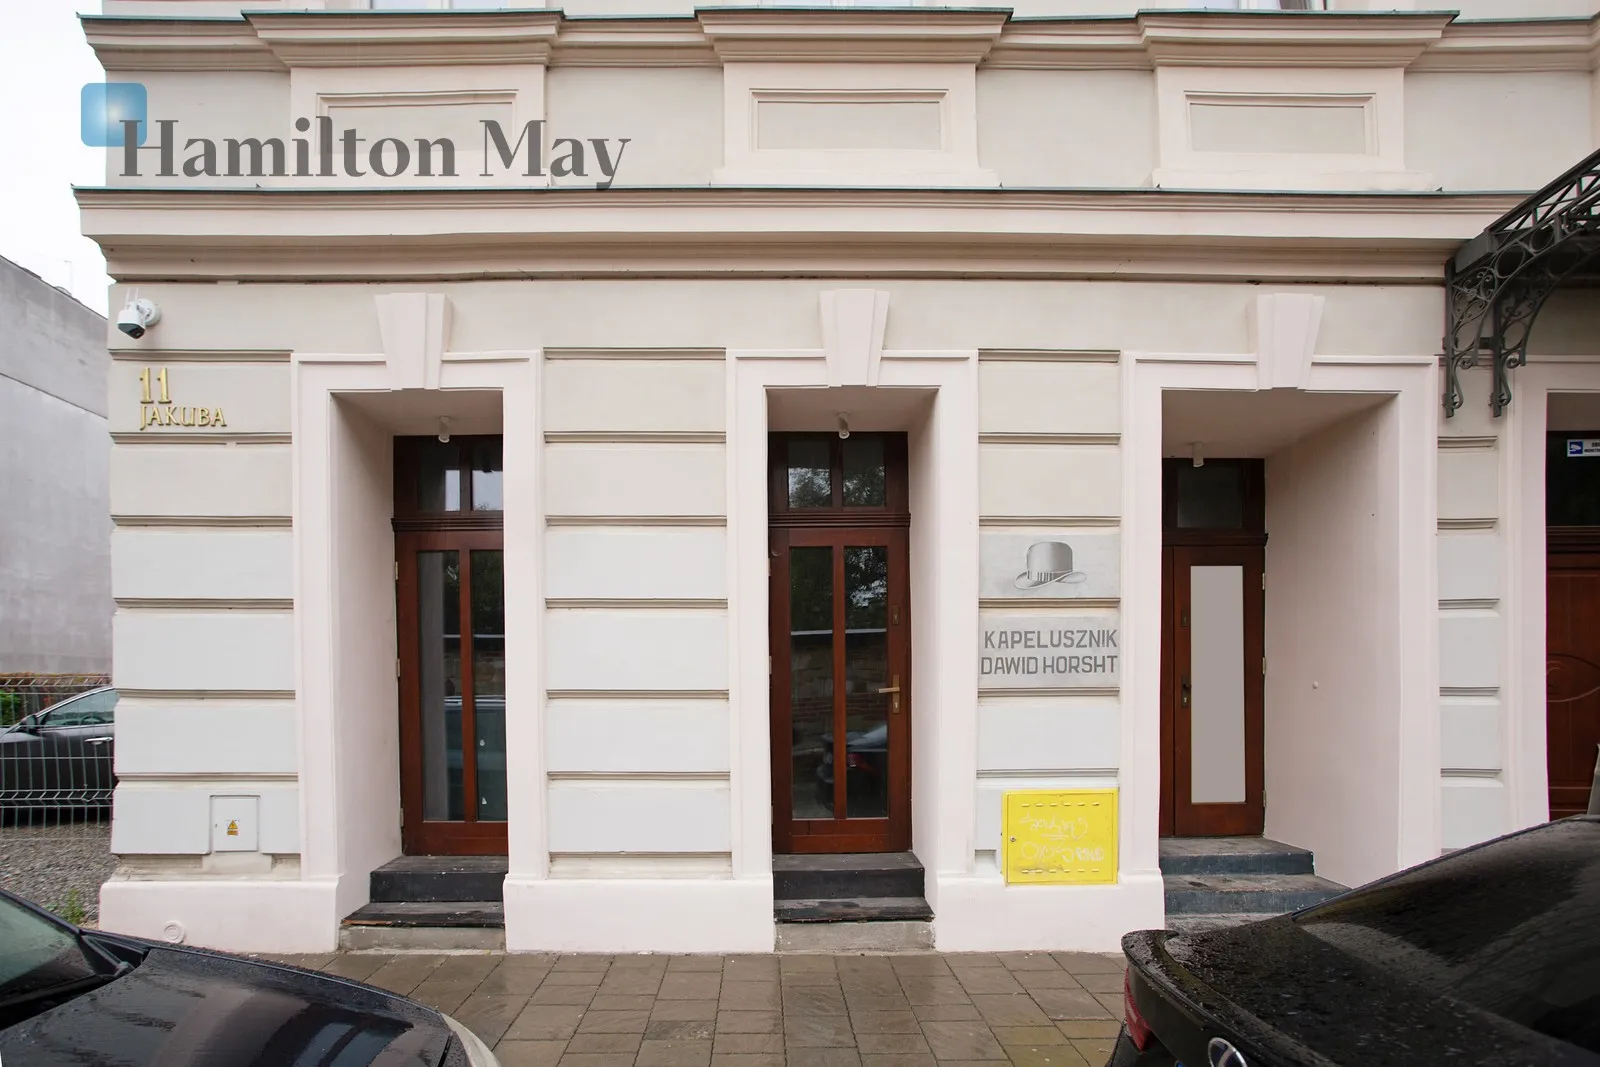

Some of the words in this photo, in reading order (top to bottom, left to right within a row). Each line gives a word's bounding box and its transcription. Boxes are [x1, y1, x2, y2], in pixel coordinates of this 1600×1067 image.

[139, 367, 171, 403] 11
[139, 405, 227, 431] JAKUBA
[984, 629, 1118, 649] KAPELUSZNIK
[980, 656, 1039, 675] DAWID
[1042, 655, 1118, 674] HORSHT
